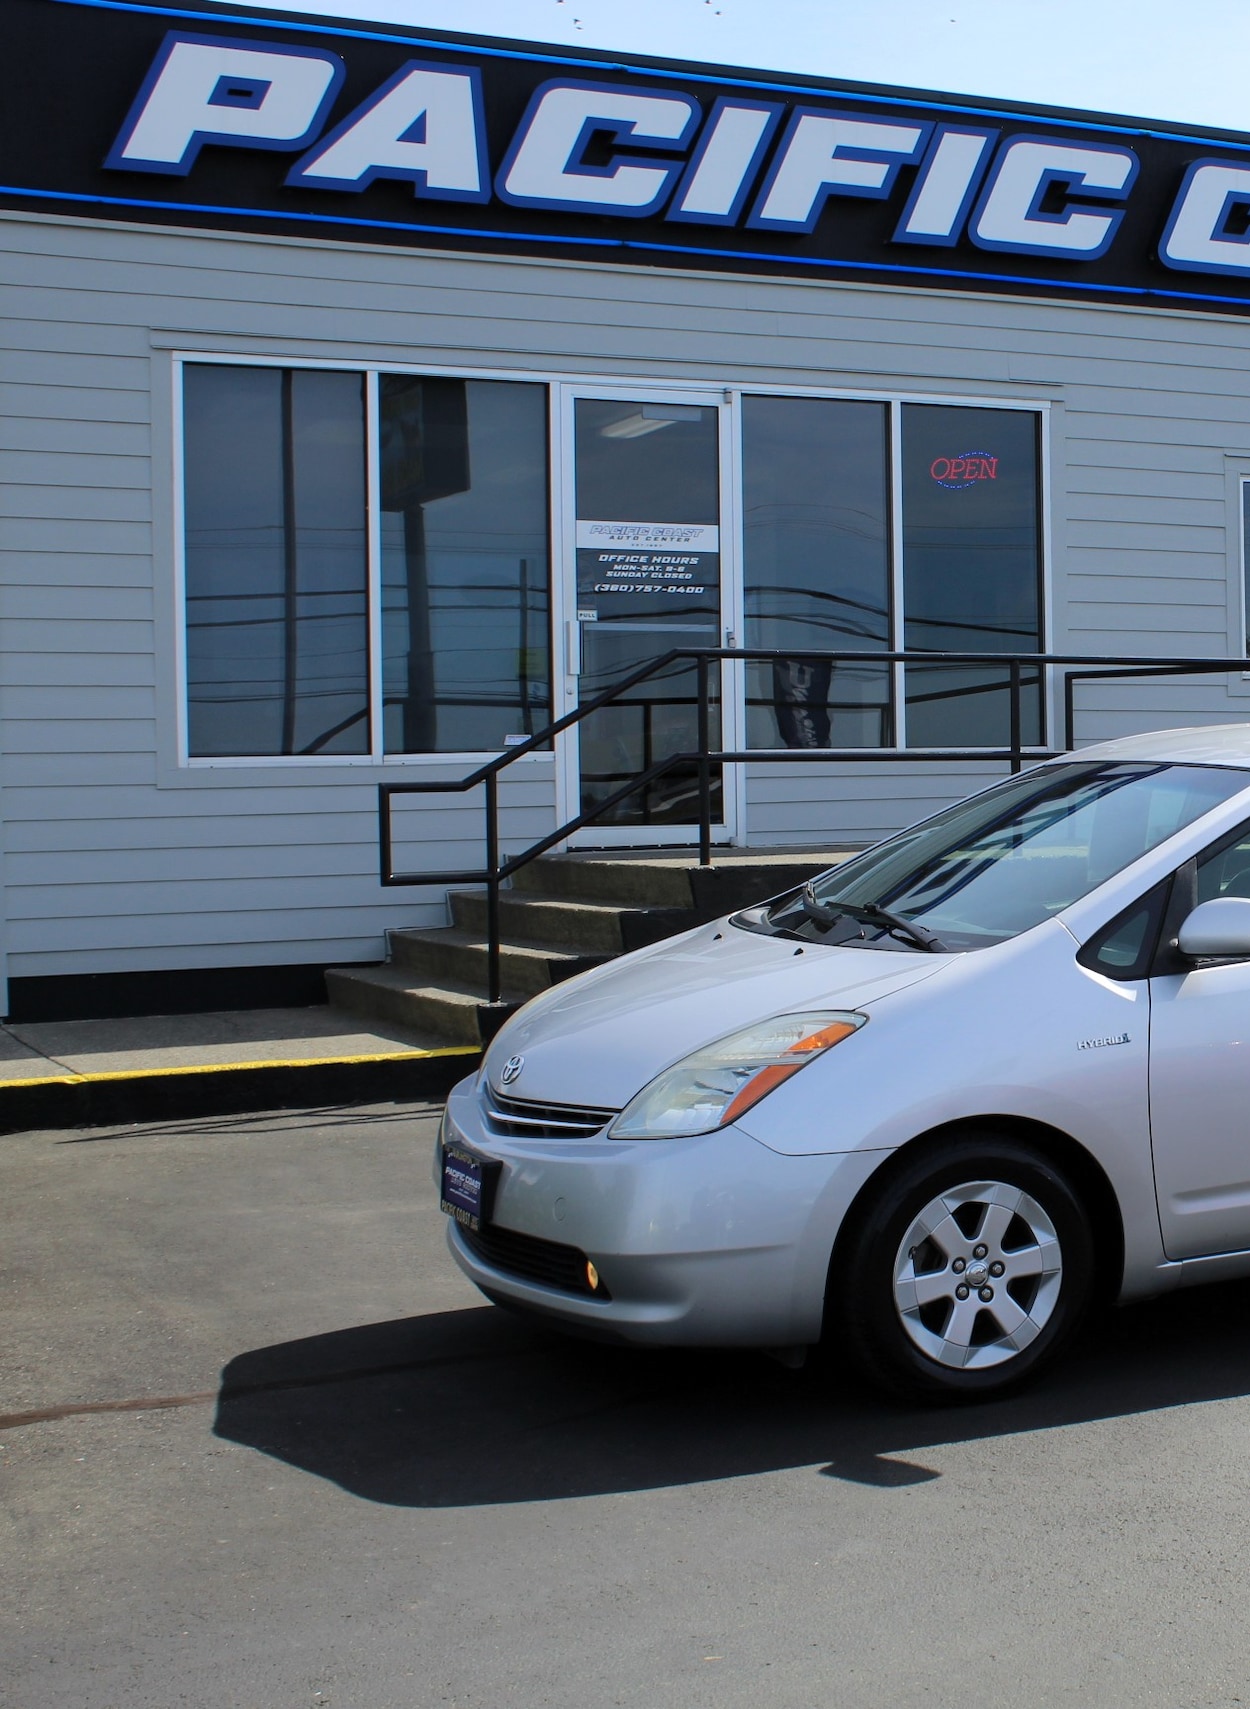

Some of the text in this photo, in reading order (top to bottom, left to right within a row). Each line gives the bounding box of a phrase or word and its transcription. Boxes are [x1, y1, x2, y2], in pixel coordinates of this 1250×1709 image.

[106, 31, 1138, 258] PACIFIC
[930, 457, 998, 480] OPEN
[590, 525, 703, 537] PACIFIC COAST
[598, 554, 700, 565] OFFICE HOURS
[1077, 1034, 1126, 1050] HYBRID
[445, 1166, 465, 1181] PACIFIC
